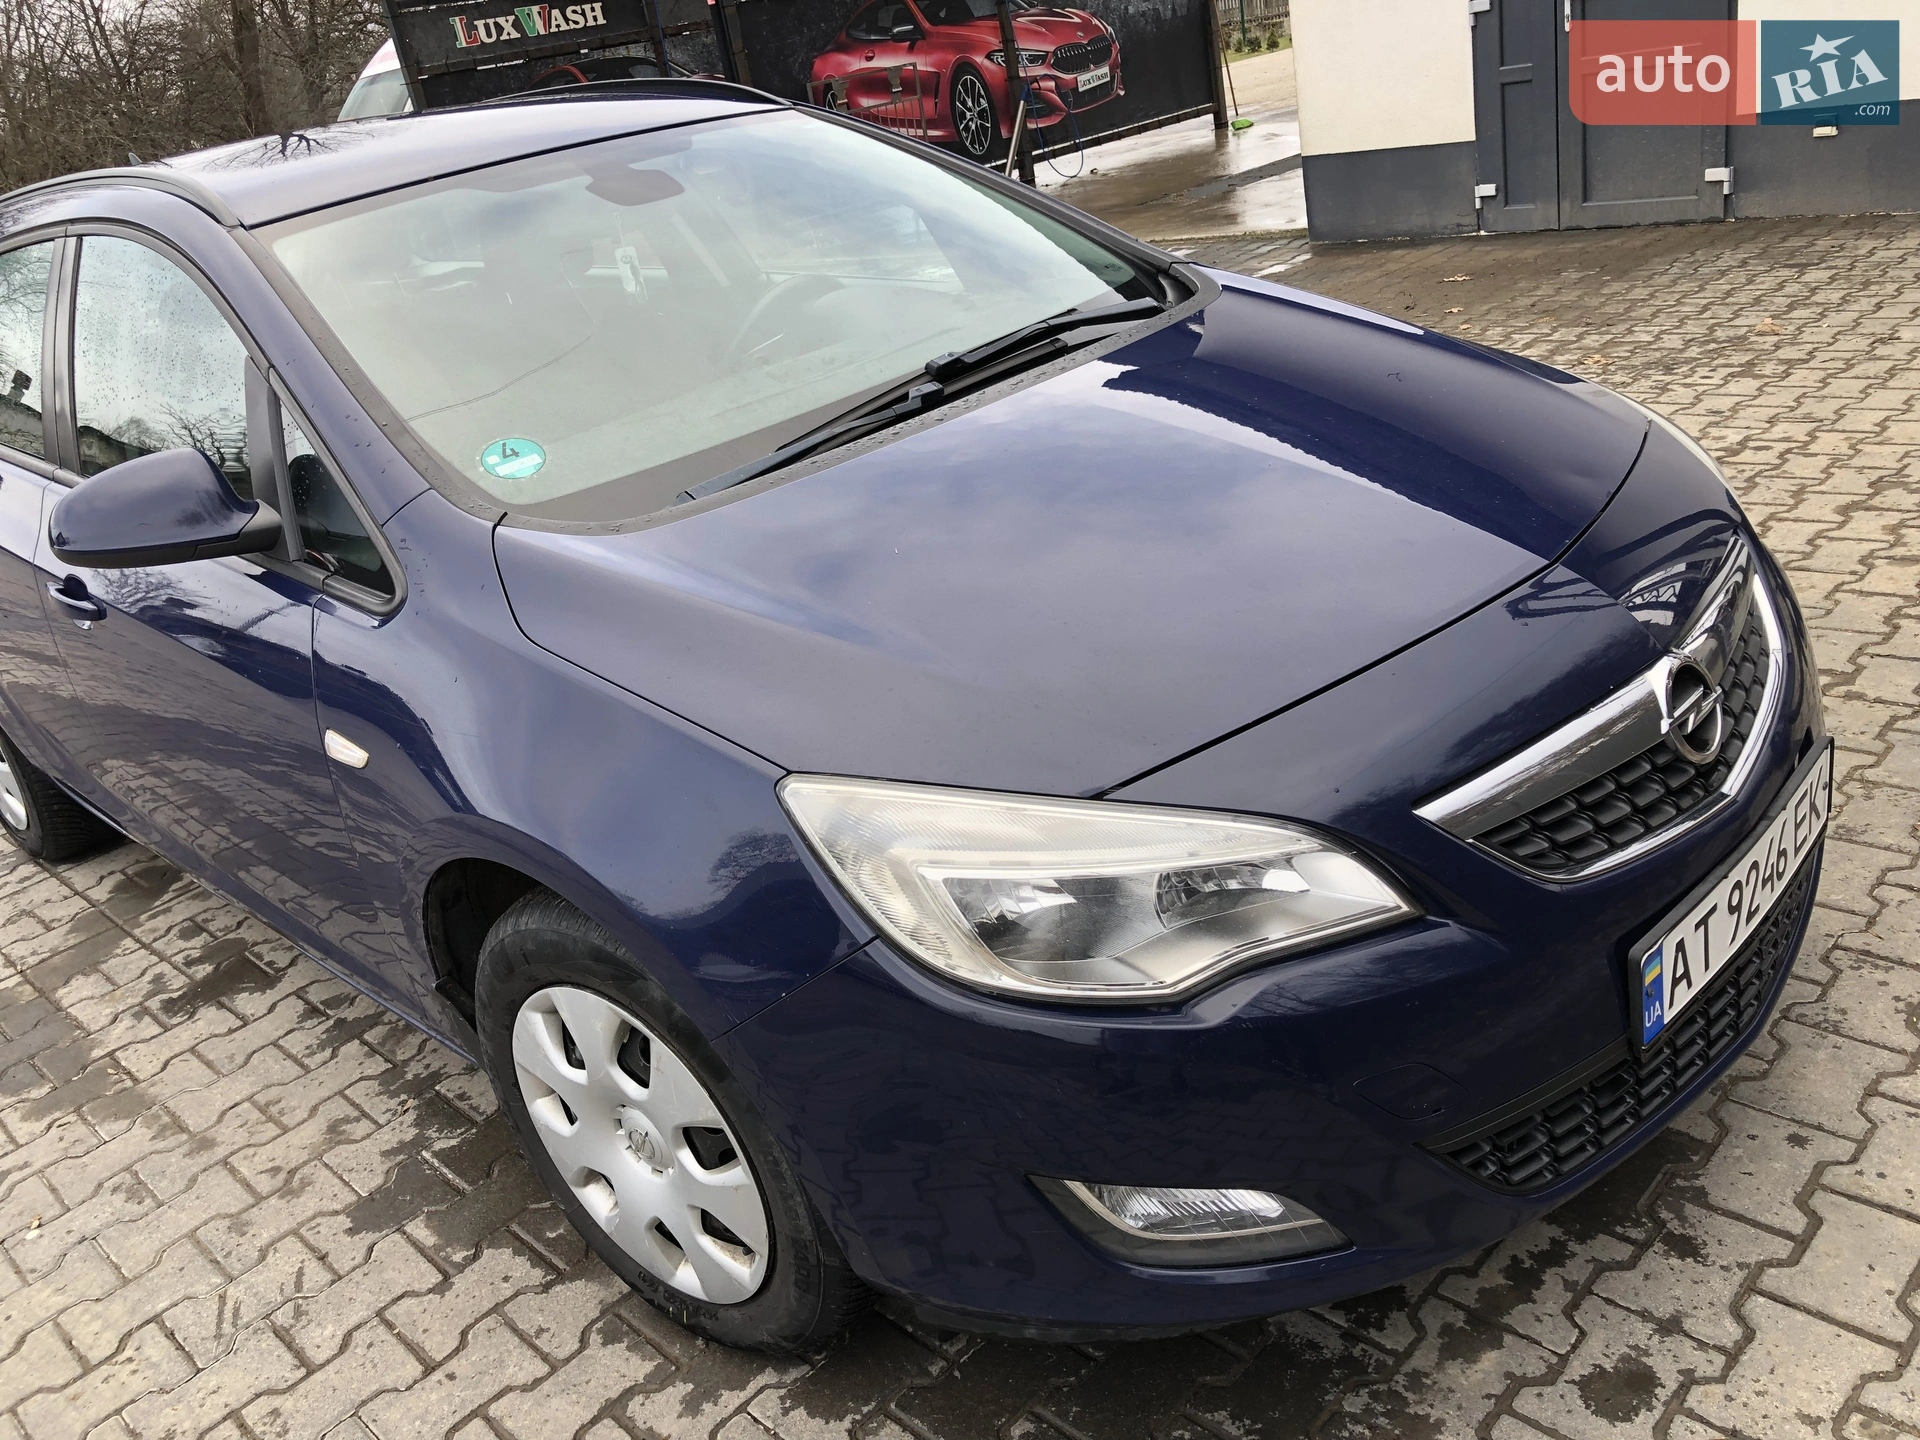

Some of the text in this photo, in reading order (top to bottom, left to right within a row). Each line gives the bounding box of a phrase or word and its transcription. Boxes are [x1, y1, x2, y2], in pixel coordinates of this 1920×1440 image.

[502, 442, 520, 459] 4
[1667, 764, 1823, 1011] AT 9246 EK
[1644, 1000, 1662, 1027] UA
